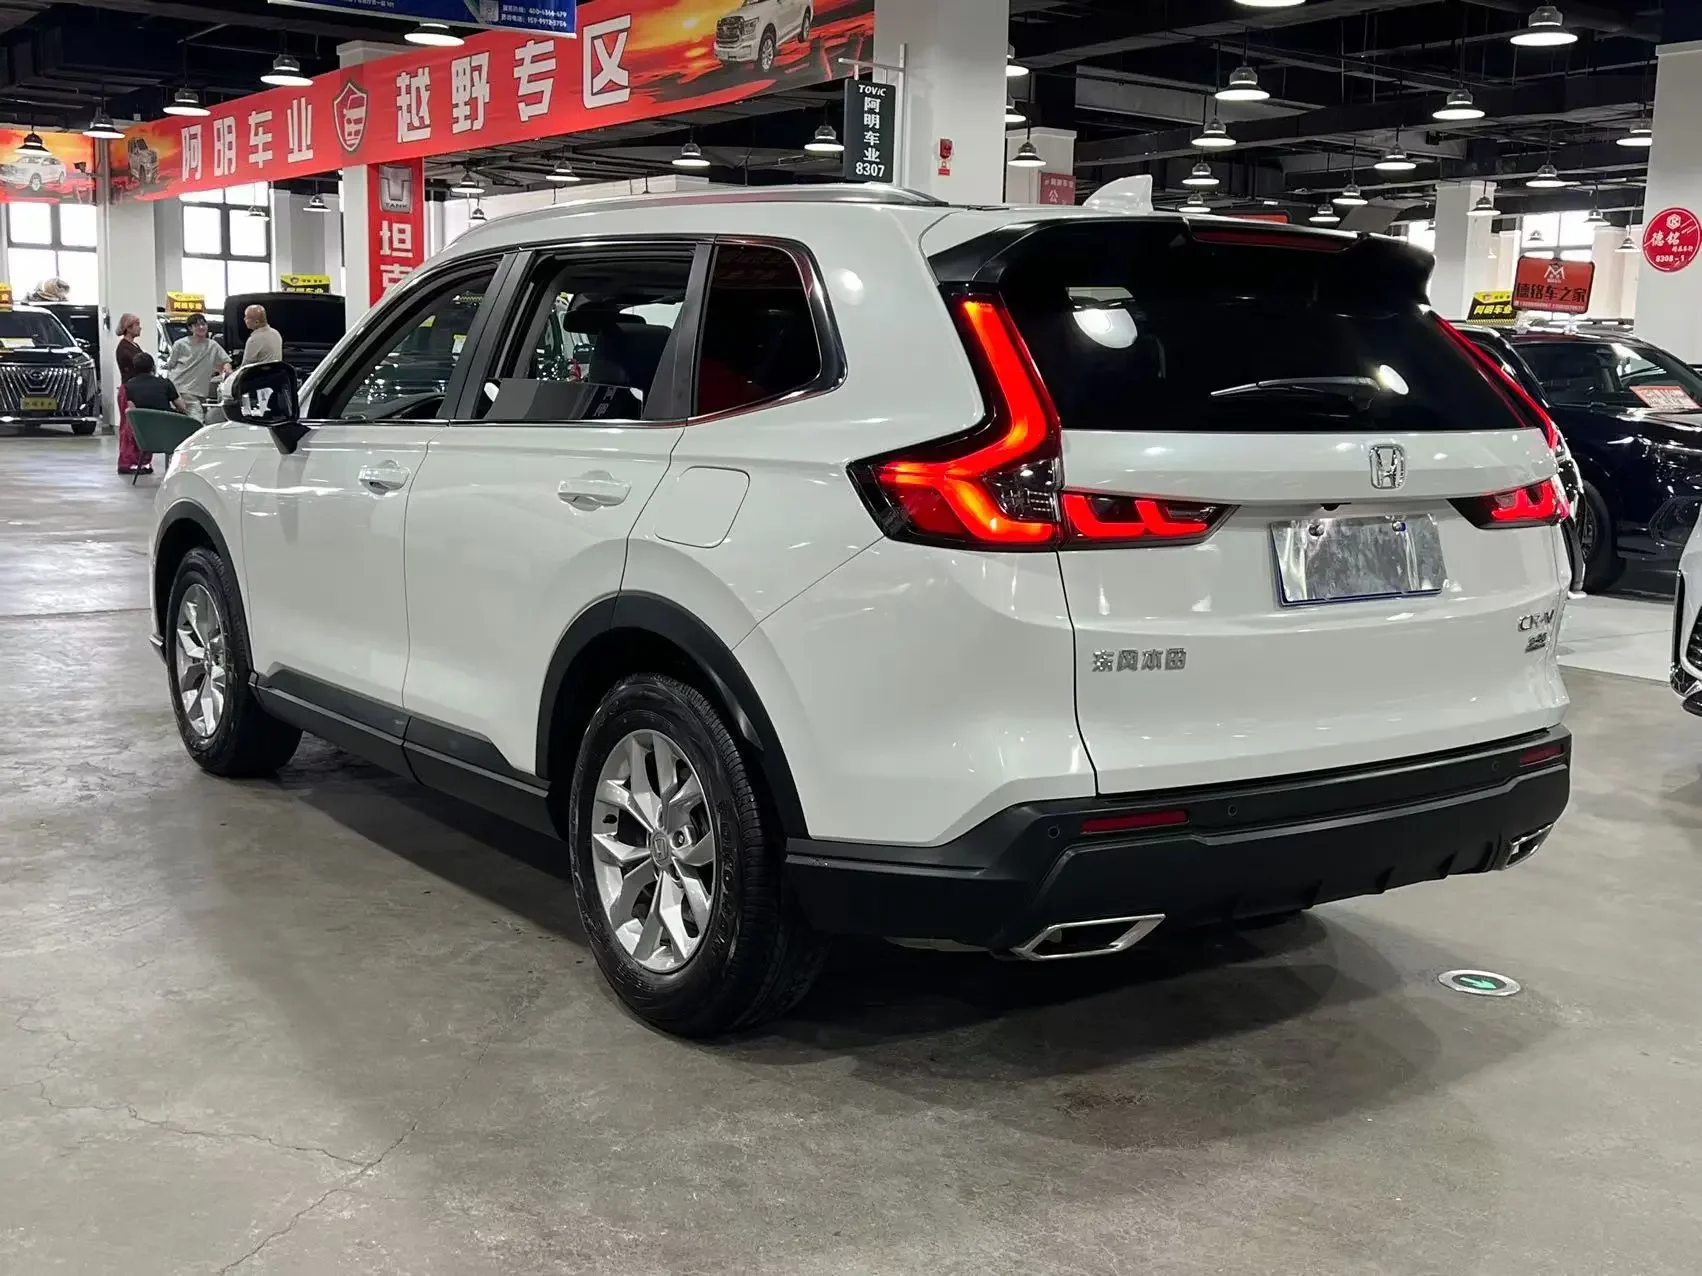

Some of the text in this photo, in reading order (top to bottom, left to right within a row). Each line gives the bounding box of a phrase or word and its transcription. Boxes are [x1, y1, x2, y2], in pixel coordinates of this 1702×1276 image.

[180, 15, 631, 182] 阿明车业 越野专区
[863, 97, 881, 162] 阿明车业
[855, 162, 885, 178] 8307
[1092, 647, 1187, 672] 东风本田
